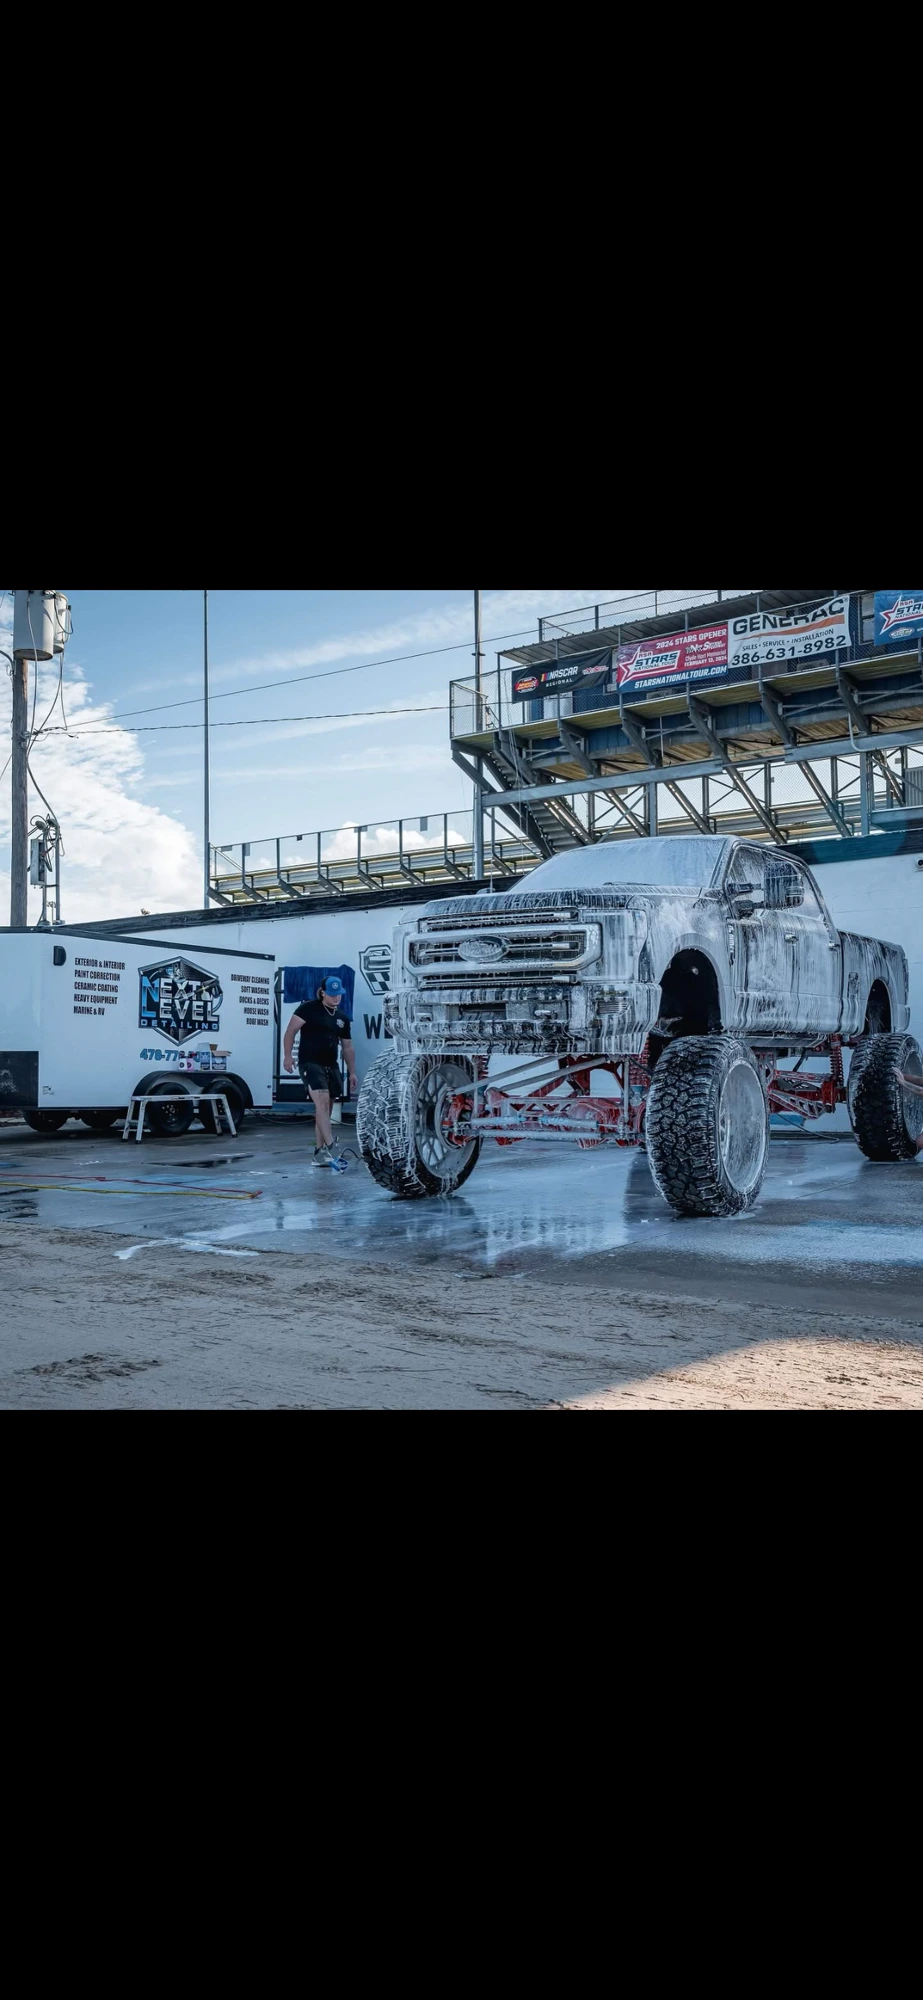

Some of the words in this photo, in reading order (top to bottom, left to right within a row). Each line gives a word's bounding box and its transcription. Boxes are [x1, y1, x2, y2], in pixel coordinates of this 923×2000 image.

[656, 641, 674, 649] 2024
[675, 634, 697, 645] STARS
[698, 629, 727, 640] OPENER
[742, 643, 758, 651] SALES
[762, 639, 785, 647] SERVICE
[791, 628, 834, 643] INSTALLATION
[731, 635, 847, 666] 386-631-8982
[634, 652, 679, 667] STARS
[684, 659, 707, 667] FEBRUARY
[634, 662, 662, 671] NATIONAL
[548, 666, 579, 680] NASCAR
[634, 665, 727, 689] STARSNATIONALTOUR.COM
[545, 678, 573, 687] REGIONAL
[75, 957, 98, 967] EXTERIOR
[103, 960, 125, 970] INTERIOR
[75, 969, 90, 978] PAINT
[90, 971, 121, 981] CORRECTION
[231, 973, 251, 983] DRIVEWAY
[251, 976, 270, 985] CLEANING
[74, 981, 97, 991] CERAMIC
[97, 983, 119, 993] COATING
[141, 976, 201, 1002] NEXT
[241, 985, 251, 993] SOFT
[251, 986, 269, 995] WASHING
[73, 993, 90, 1002] HEAVY
[90, 995, 118, 1004] EQUIPMENT
[239, 996, 253, 1004] DOCKS
[73, 1005, 93, 1015] MARINE
[98, 1007, 105, 1015] RV
[141, 998, 219, 1021] LEVEL
[244, 1007, 257, 1015] HOUSE
[257, 1008, 269, 1016] WASH
[140, 1019, 219, 1030] DETAILING
[246, 1017, 257, 1025] ROOF
[257, 1018, 269, 1026] WASH
